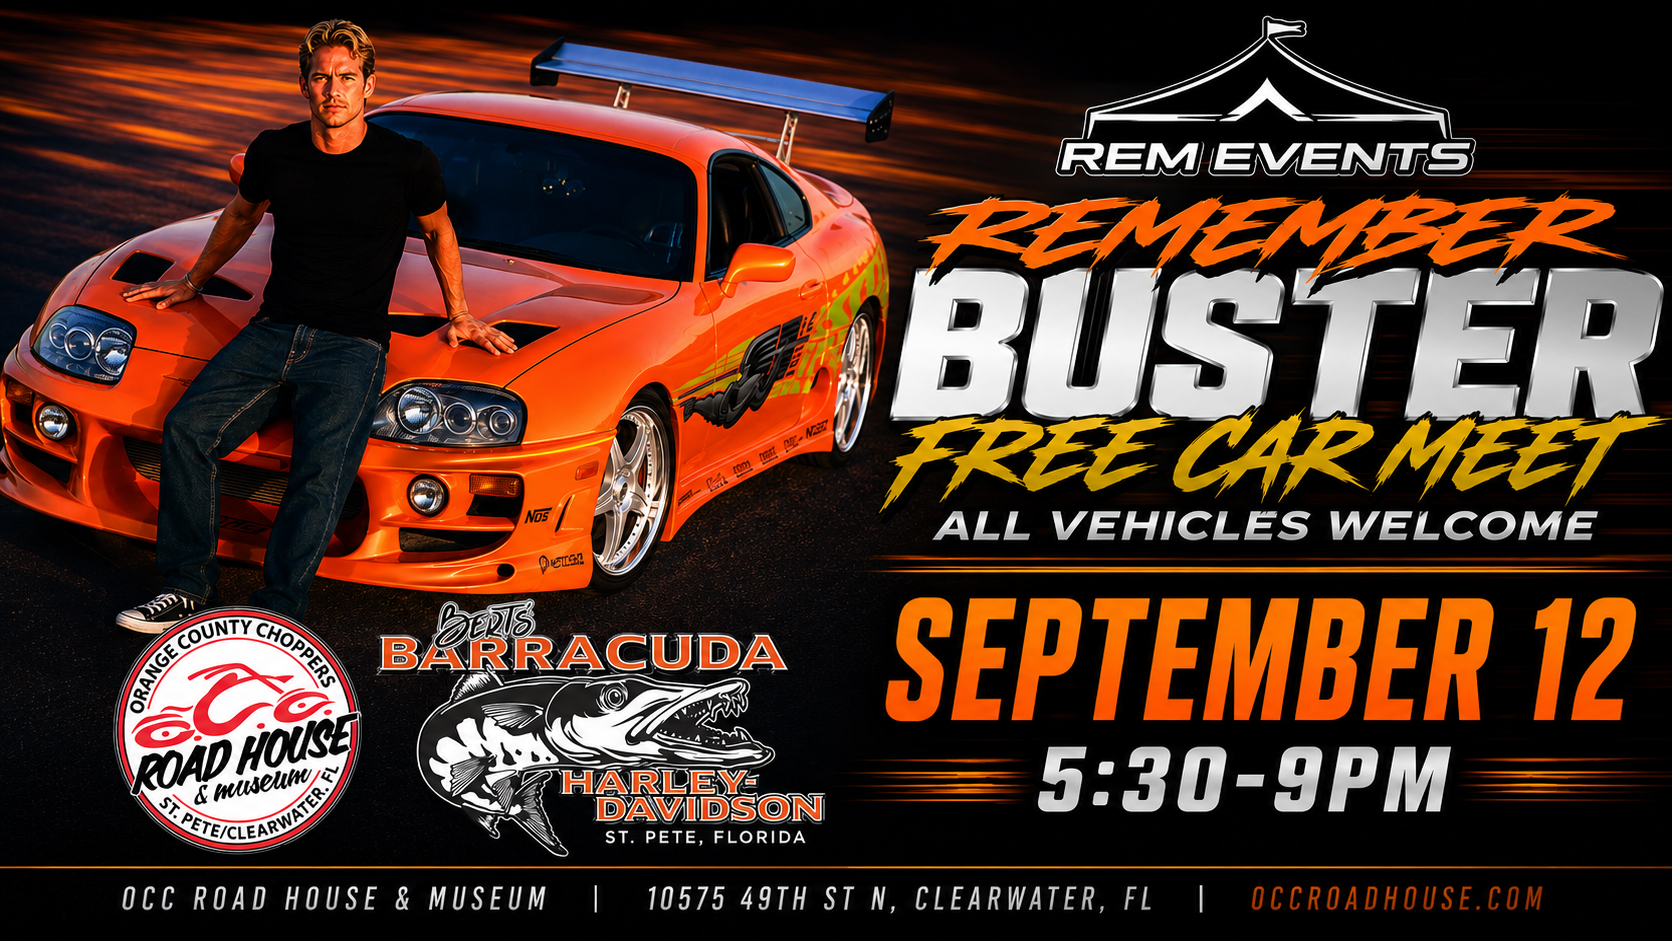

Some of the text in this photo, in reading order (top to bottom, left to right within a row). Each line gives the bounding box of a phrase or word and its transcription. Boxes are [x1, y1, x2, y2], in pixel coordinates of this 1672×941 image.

[1061, 142, 1473, 171] REM EVENTS
[922, 193, 1630, 283] REMEMBER
[890, 267, 1664, 421] BUSTER
[879, 409, 1660, 513] FREE CAR MEET
[932, 511, 1599, 541] ALL VEHICLES WELCOME
[129, 619, 336, 714] ORANGE COUNTY CHOPPERS
[379, 634, 789, 671] BARRACUDA
[885, 597, 1637, 722] SEPTEMBER 12
[131, 712, 360, 795] ROAD HOUSE
[159, 796, 179, 819] ST.
[320, 765, 340, 783] FL
[194, 768, 312, 806] & museum
[561, 769, 758, 795] HARLEY-
[1037, 747, 1452, 813] 5:30-9PM
[595, 795, 824, 822] DAVIDSON
[605, 830, 806, 846] ST. PETE, FLORIDA
[121, 885, 546, 911] OCC ROAD HOUSE & MUSEUM
[648, 885, 1151, 914] 10575 49TH ST N, CLEARWATER, FL
[1251, 885, 1543, 911] OCCROADHOUSE.COM
